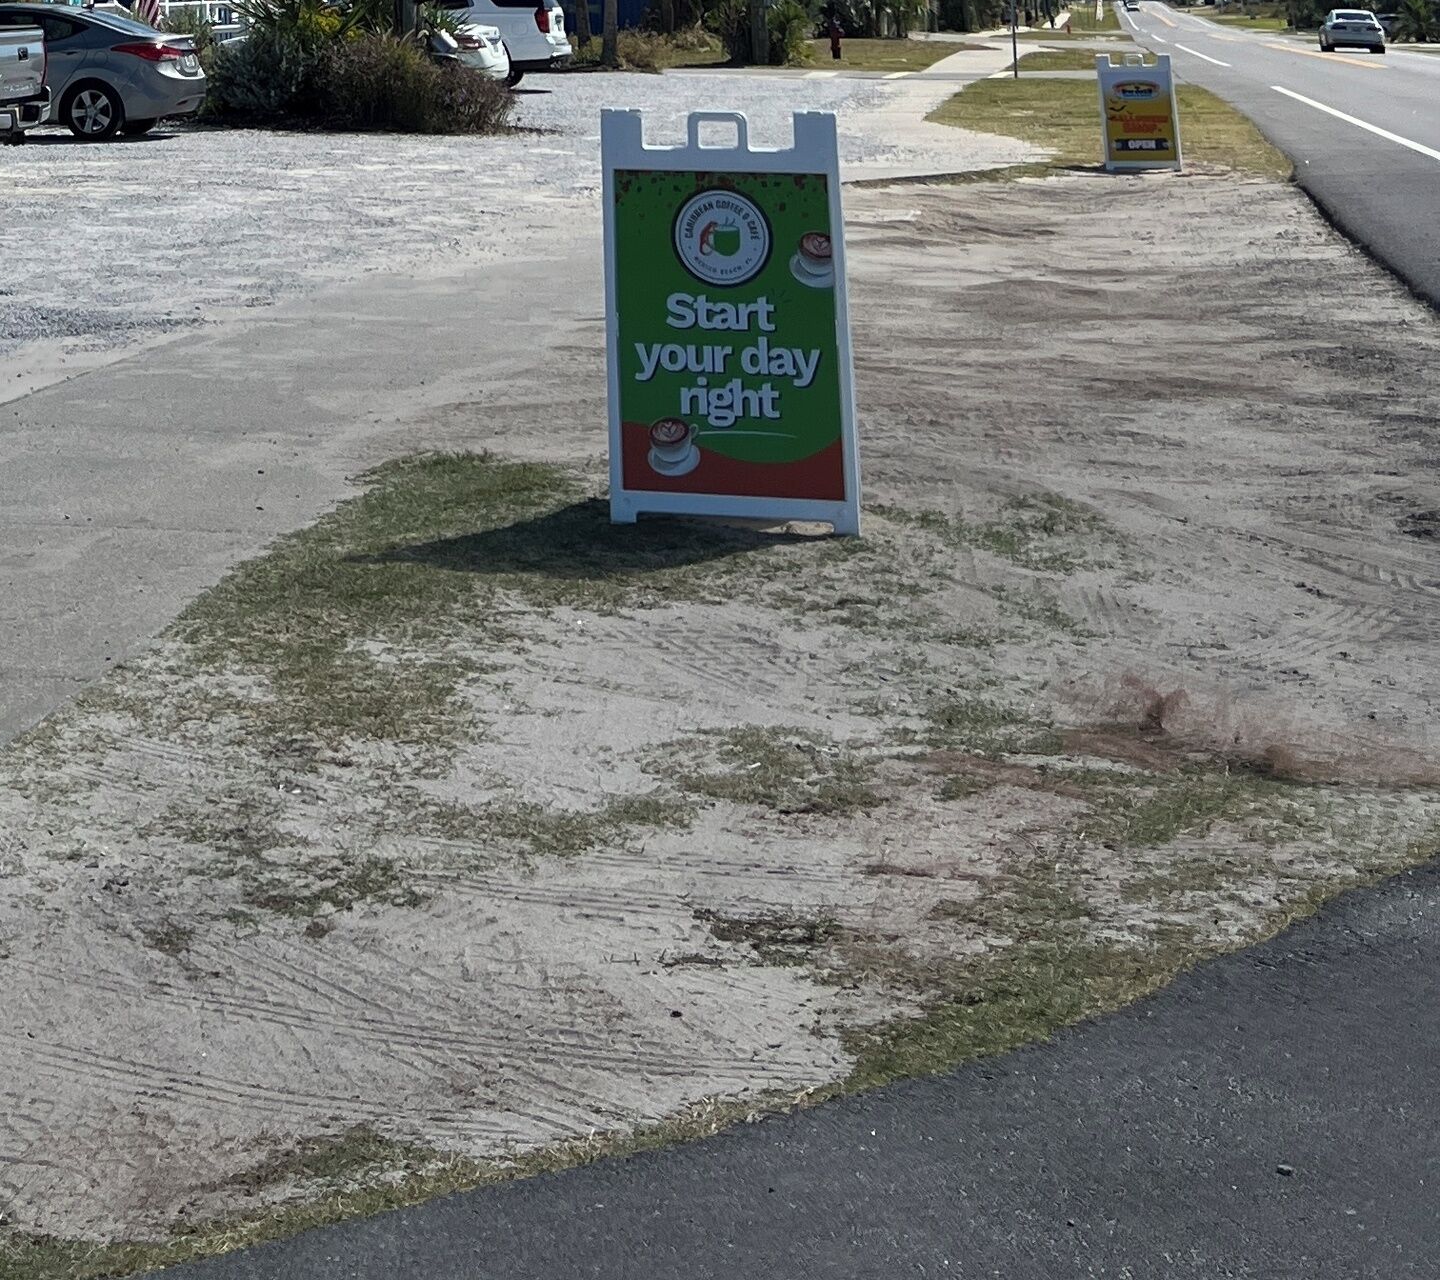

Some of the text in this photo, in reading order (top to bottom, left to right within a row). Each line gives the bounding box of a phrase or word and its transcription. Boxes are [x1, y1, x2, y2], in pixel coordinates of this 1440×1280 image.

[685, 201, 714, 239] CARIBBEAN
[716, 200, 743, 216] COFFEE
[666, 292, 776, 332] Start
[634, 336, 821, 388] your day
[680, 377, 781, 427] right
